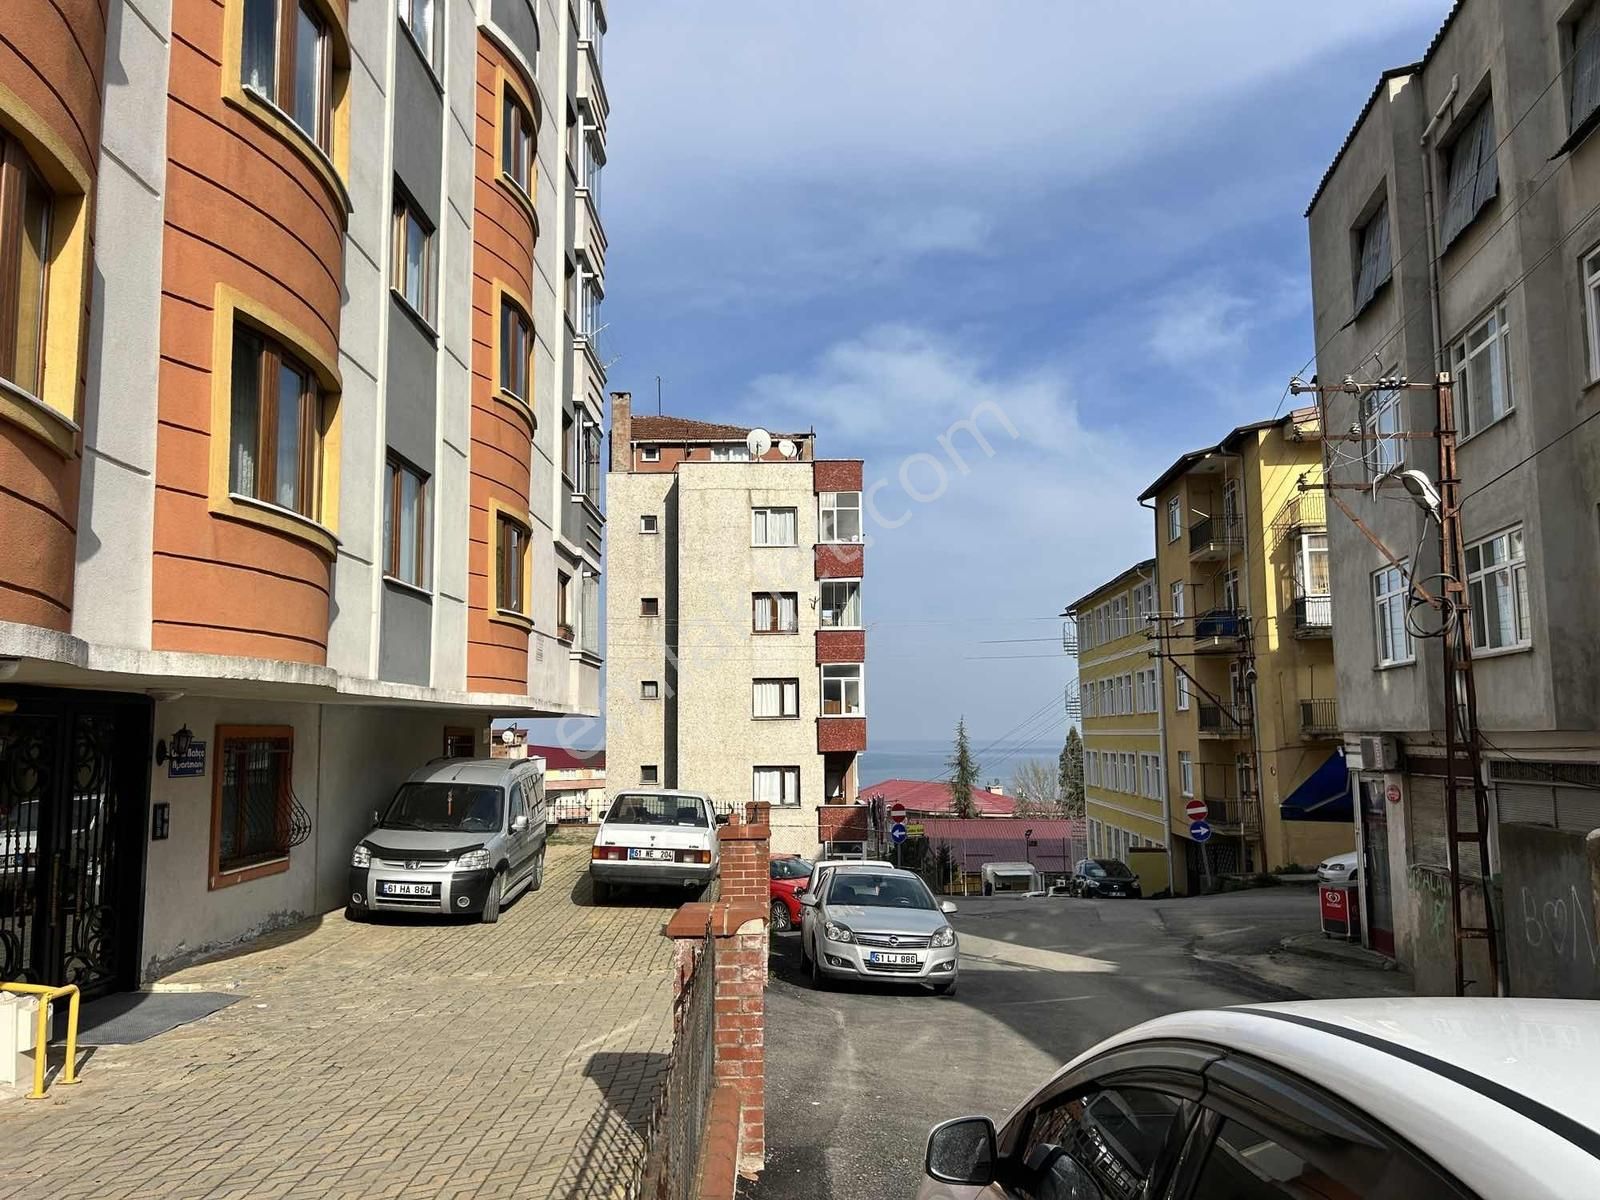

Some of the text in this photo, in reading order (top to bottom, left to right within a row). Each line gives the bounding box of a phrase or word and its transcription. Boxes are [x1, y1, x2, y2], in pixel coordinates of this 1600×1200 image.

[634, 849, 642, 857] 61
[660, 850, 672, 859] 204
[387, 884, 431, 894] 61 HA 864
[875, 953, 916, 964] 61 LJ 886
